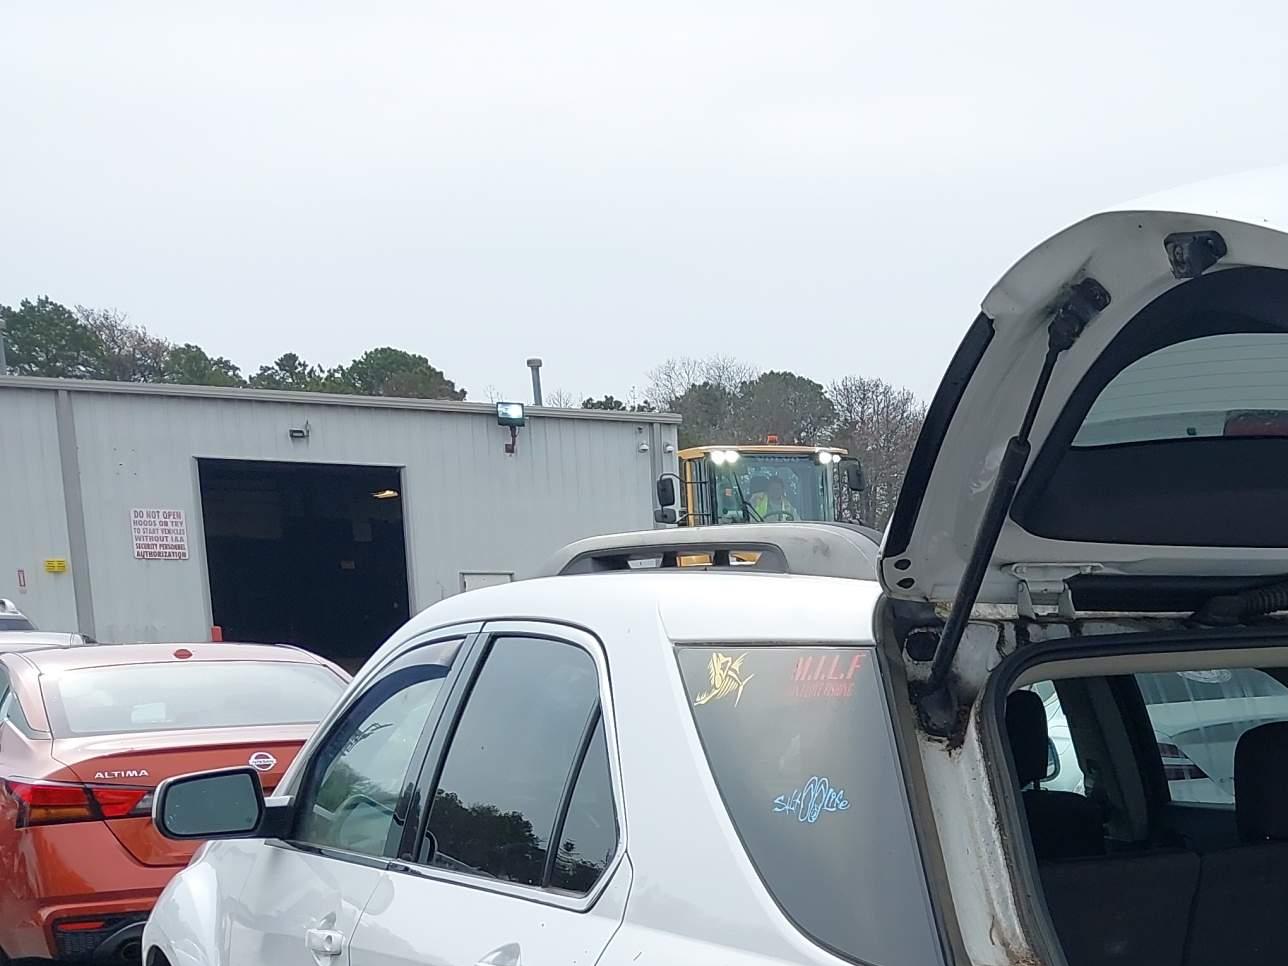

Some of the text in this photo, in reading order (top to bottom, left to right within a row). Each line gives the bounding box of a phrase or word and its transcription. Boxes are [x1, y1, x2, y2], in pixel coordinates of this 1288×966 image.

[133, 510, 182, 520] DO NOT OPEN
[133, 519, 157, 527] HOODS
[133, 527, 141, 535] TO
[134, 535, 169, 543] WITHOUT
[136, 550, 187, 558] AUTHORIZATION
[94, 769, 149, 779] ALTIMA
